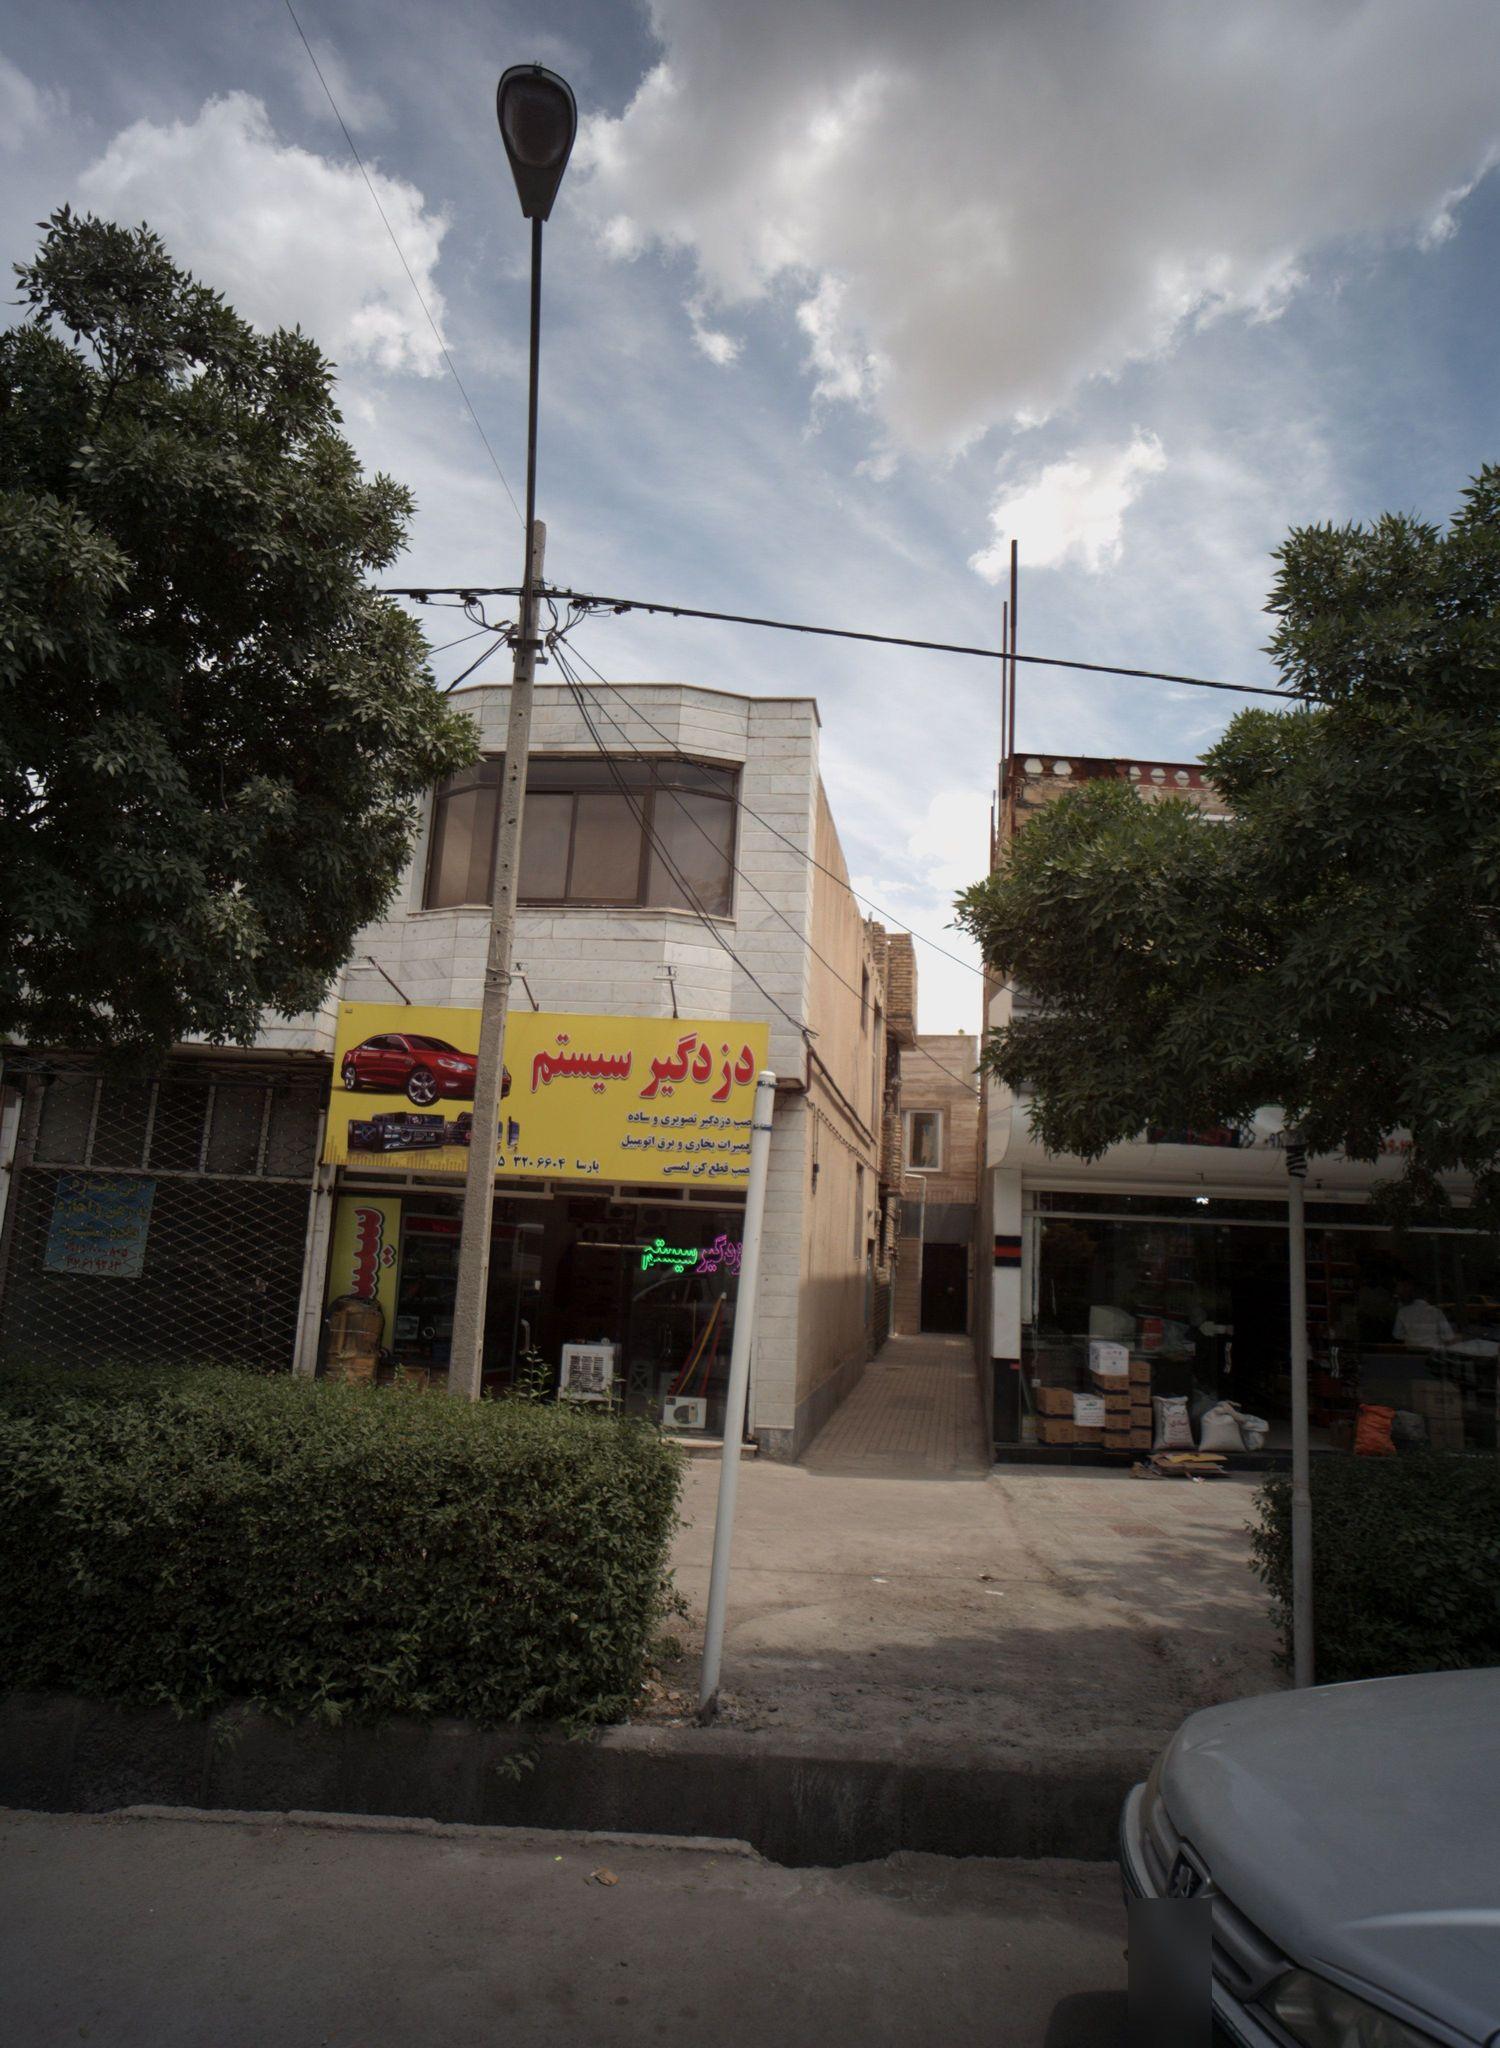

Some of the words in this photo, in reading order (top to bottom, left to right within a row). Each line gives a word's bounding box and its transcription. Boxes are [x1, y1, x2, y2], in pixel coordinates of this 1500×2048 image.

[530, 1034, 631, 1094] سیستم
[640, 1032, 755, 1102] دزدگیر
[628, 1111, 650, 1122] ساده
[661, 1113, 697, 1126] تصویری
[733, 1119, 752, 1129] صب
[621, 1135, 655, 1149] اتومبیل
[657, 1138, 675, 1150] برق
[663, 1161, 690, 1174] لمسی
[731, 1167, 750, 1178] صب
